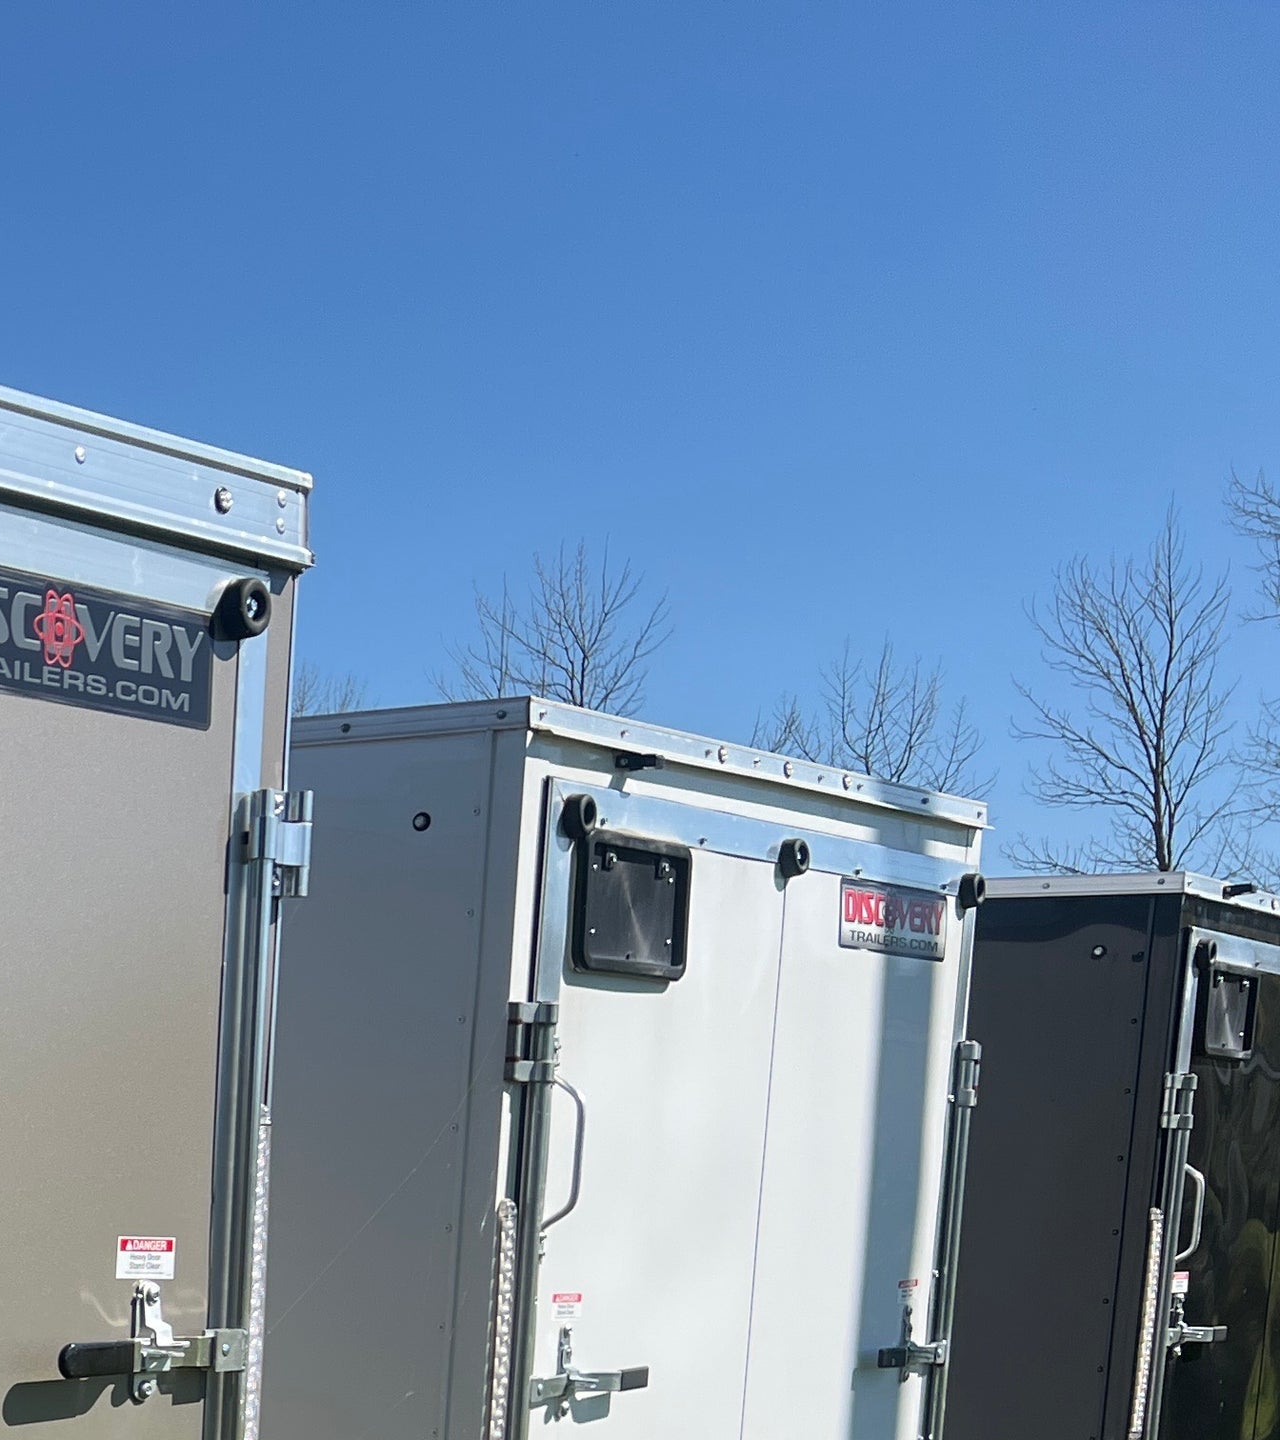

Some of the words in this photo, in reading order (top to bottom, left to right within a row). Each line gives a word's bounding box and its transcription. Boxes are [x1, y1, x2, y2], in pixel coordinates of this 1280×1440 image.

[844, 887, 944, 936] DISCOVERY
[849, 929, 938, 953] TRAILERS.COM
[133, 1239, 167, 1251] DANGER
